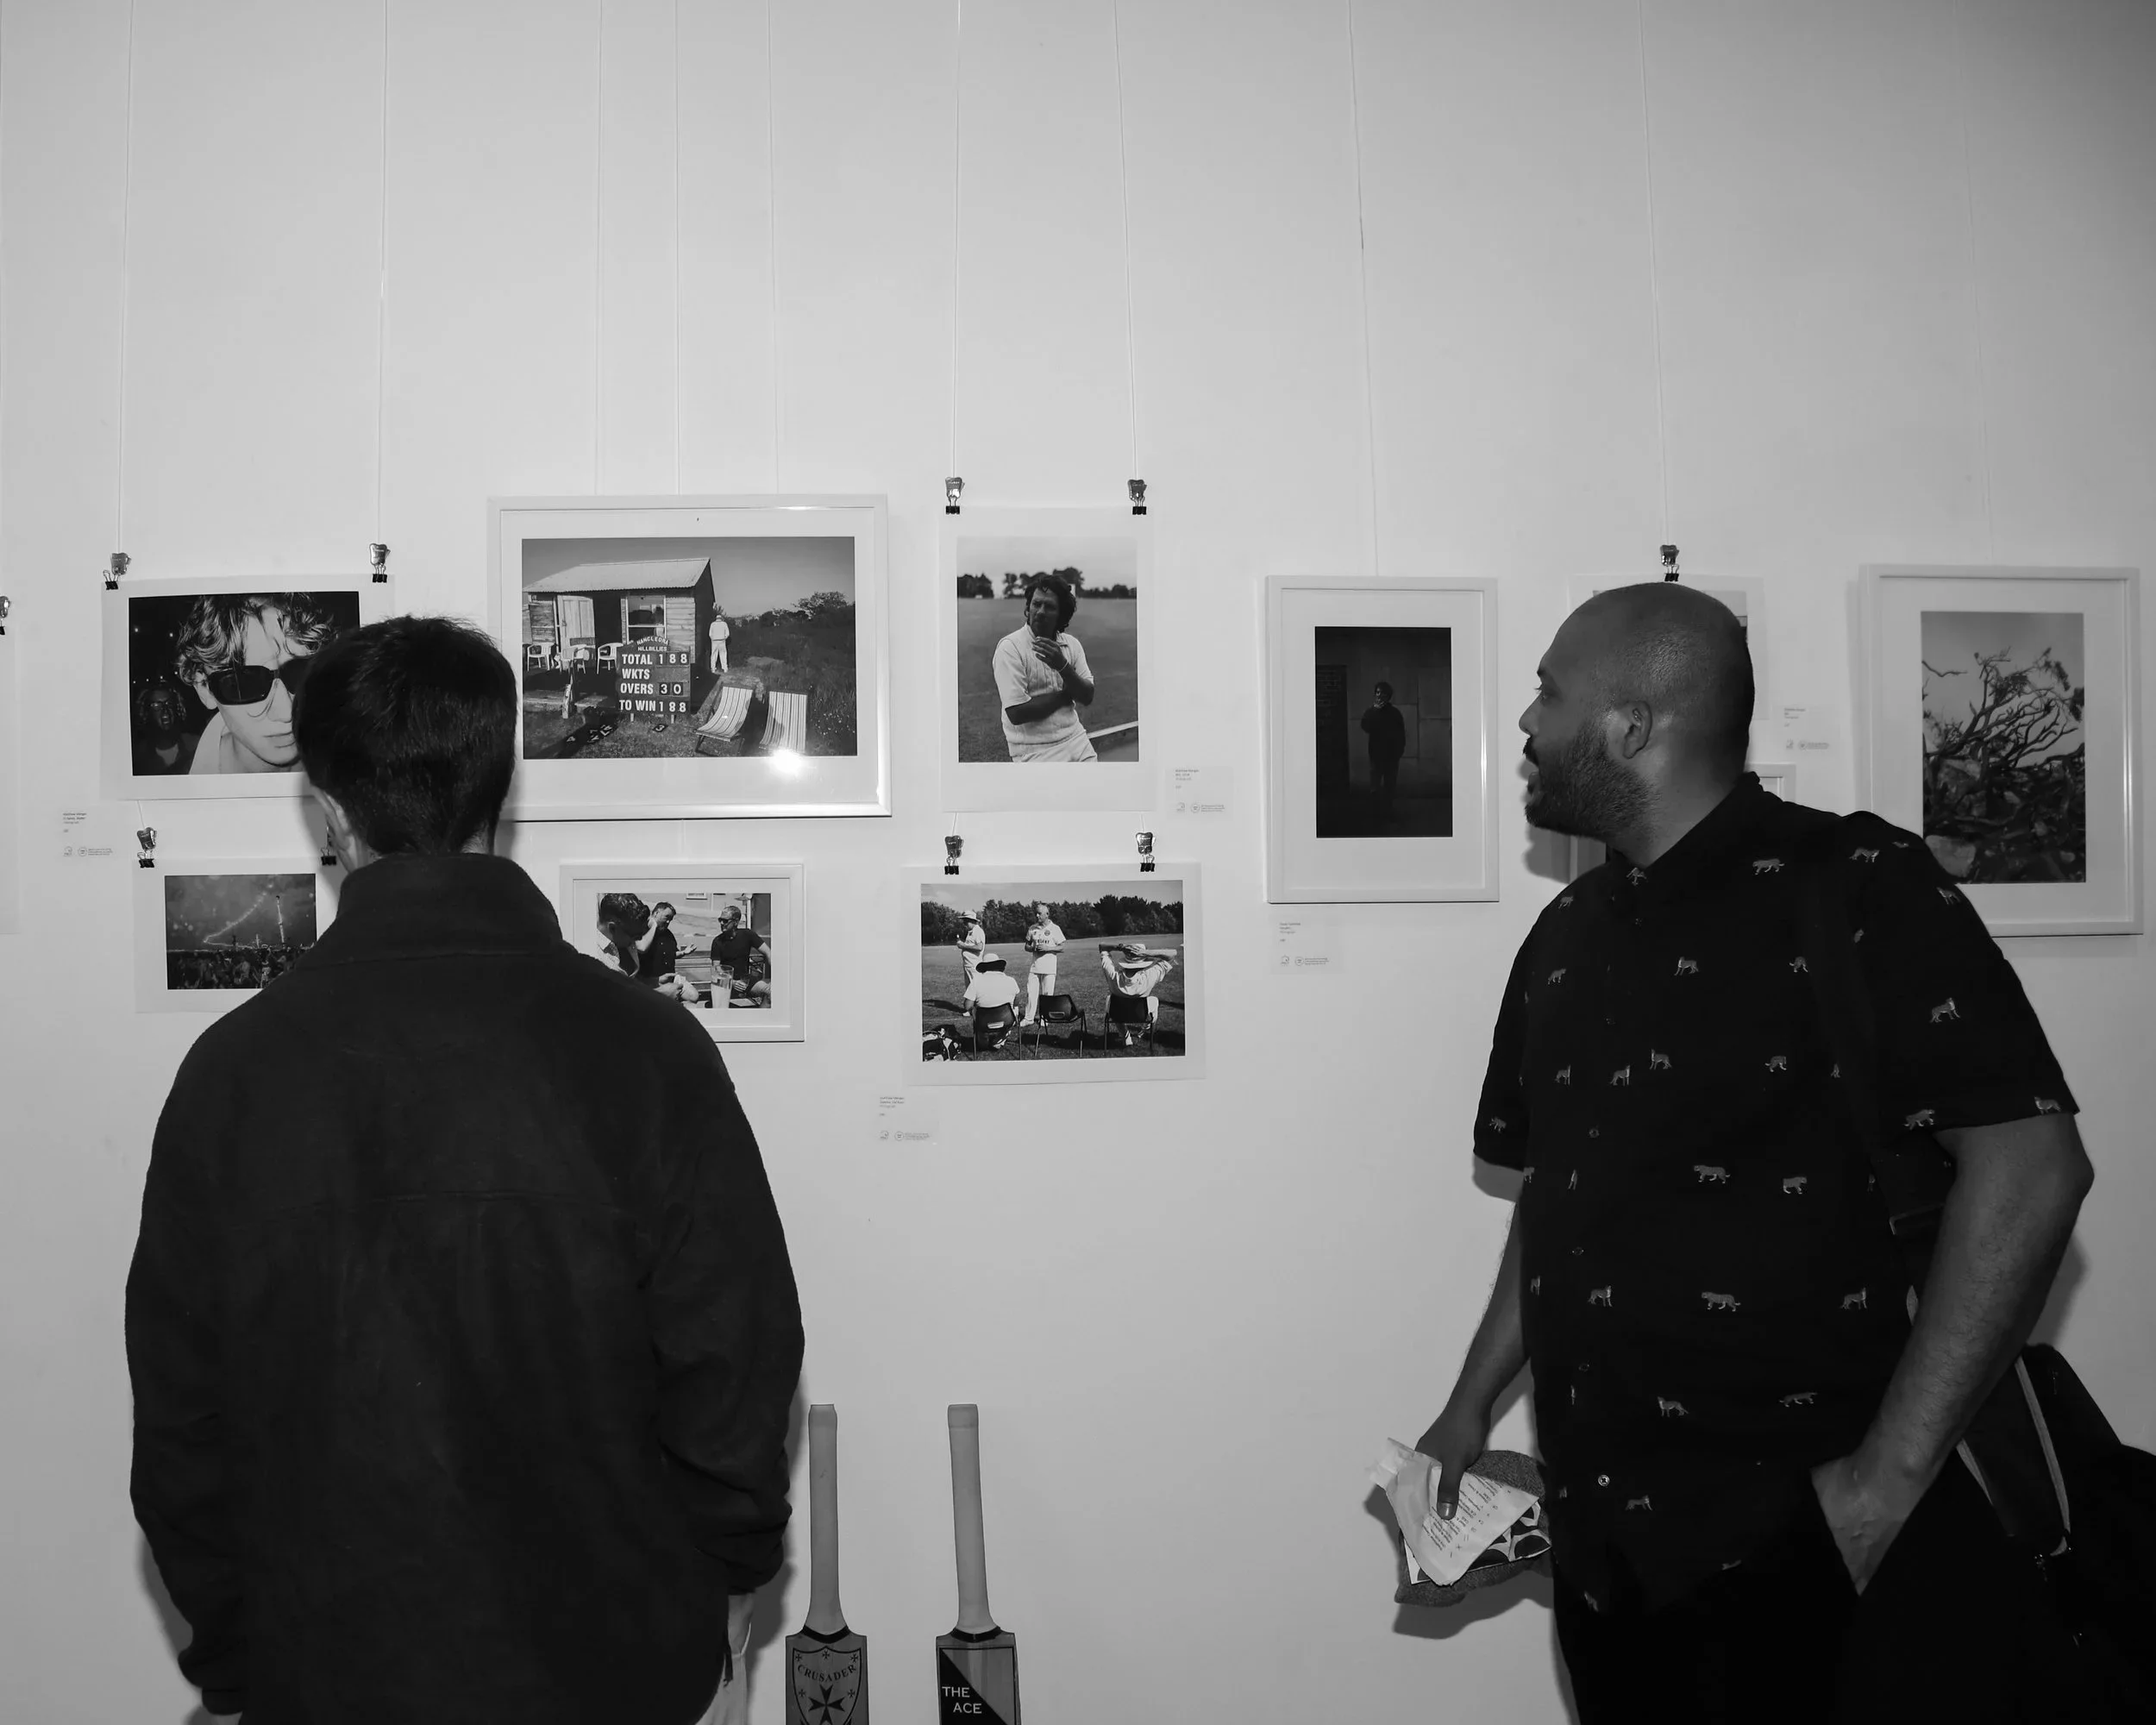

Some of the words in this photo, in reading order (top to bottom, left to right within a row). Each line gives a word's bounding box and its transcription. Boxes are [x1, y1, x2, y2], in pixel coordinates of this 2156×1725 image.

[622, 654, 653, 665] TOTAL
[622, 668, 650, 680] WKTS
[620, 682, 654, 694] OVERS
[618, 699, 632, 711] TO
[635, 699, 656, 712] WIN
[796, 1663, 857, 1683] CRUSADER
[941, 1686, 970, 1698] THE
[952, 1703, 982, 1715] ACE
